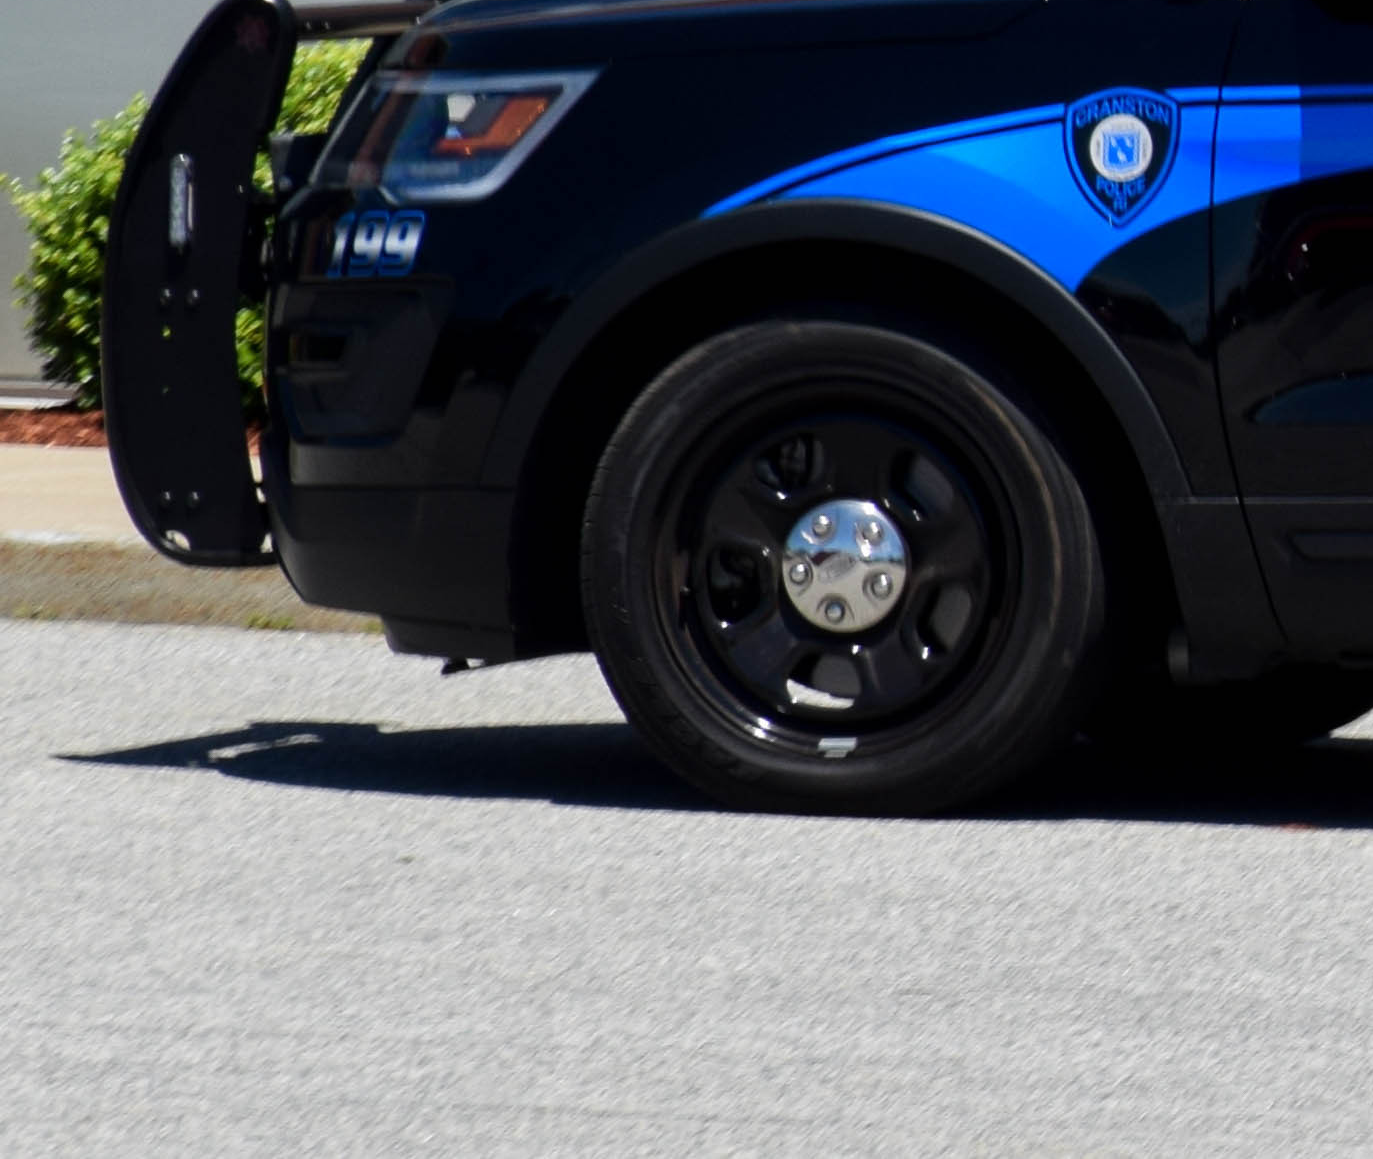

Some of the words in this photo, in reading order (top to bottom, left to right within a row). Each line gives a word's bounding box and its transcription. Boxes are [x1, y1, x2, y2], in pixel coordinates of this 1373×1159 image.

[1075, 97, 1169, 128] CRANSTON
[1096, 174, 1145, 198] POLICE
[325, 210, 427, 277] 199
